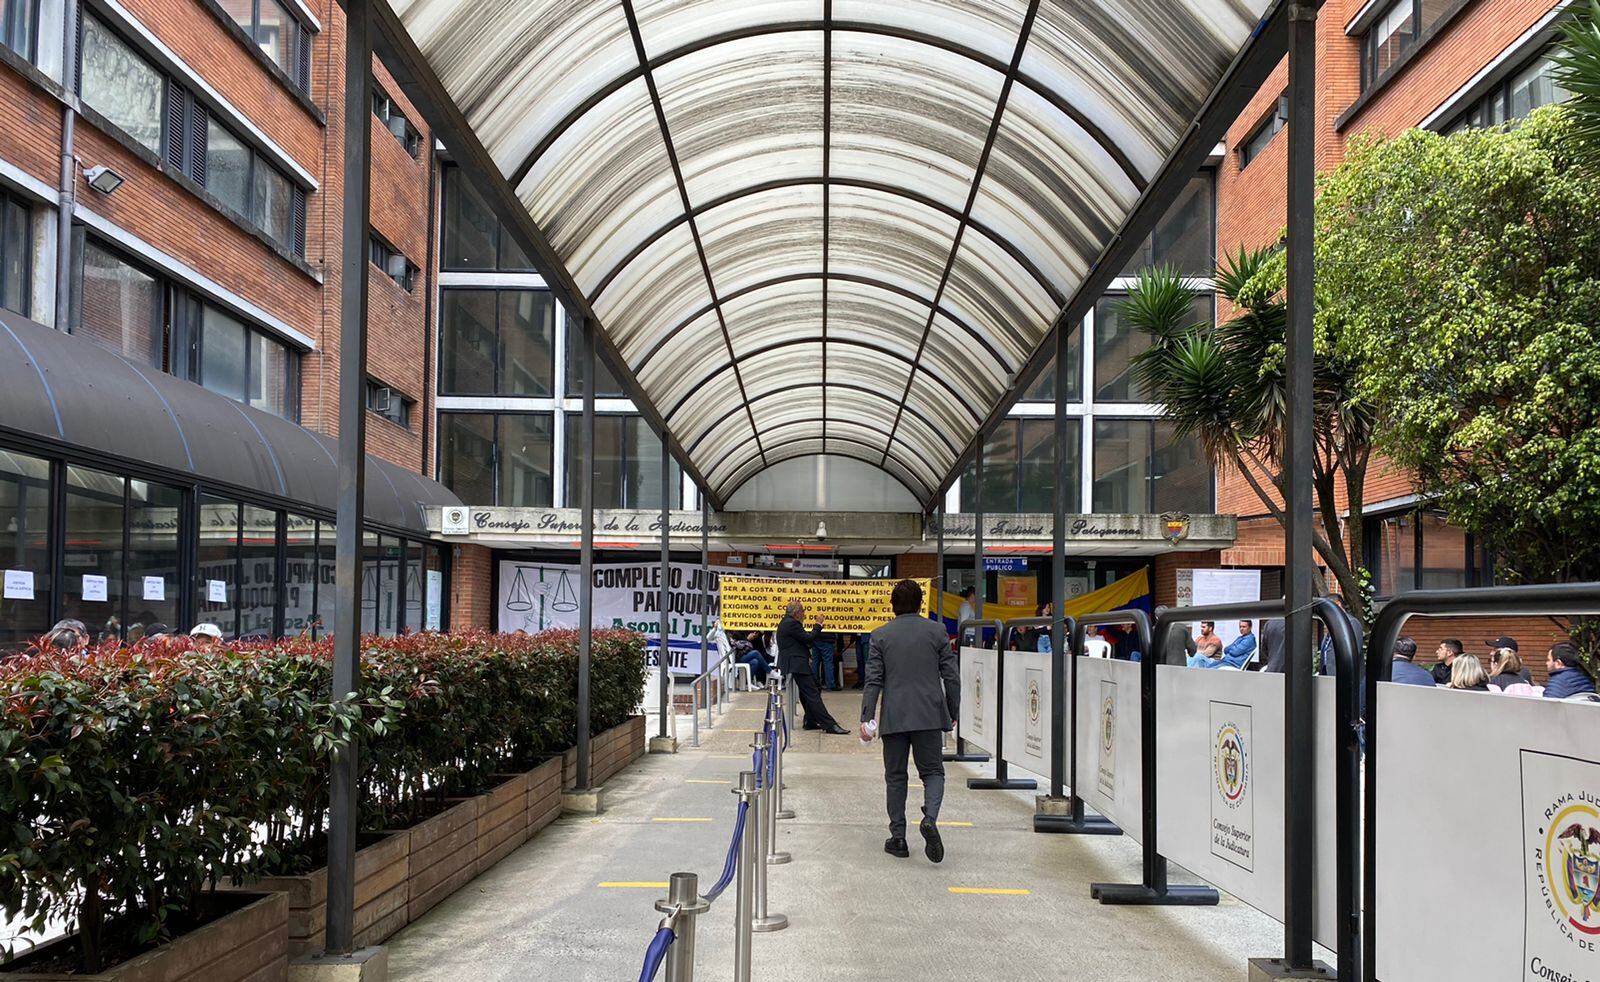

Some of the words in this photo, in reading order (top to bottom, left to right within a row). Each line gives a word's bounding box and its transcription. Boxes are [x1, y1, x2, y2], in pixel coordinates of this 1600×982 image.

[474, 512, 530, 532] Consejo
[537, 513, 596, 532] Super
[603, 516, 619, 531] de
[625, 516, 639, 531] la
[990, 520, 1044, 536] Judicial
[1070, 519, 1141, 537] Paloquemao
[1544, 792, 1575, 820] RAMA
[1213, 818, 1231, 836] Consejo
[1231, 824, 1252, 842] Superior
[1214, 833, 1220, 845] de
[1225, 838, 1250, 858] Judicatura
[1535, 847, 1575, 942] REPÚBLICA
[1579, 939, 1595, 952] DE
